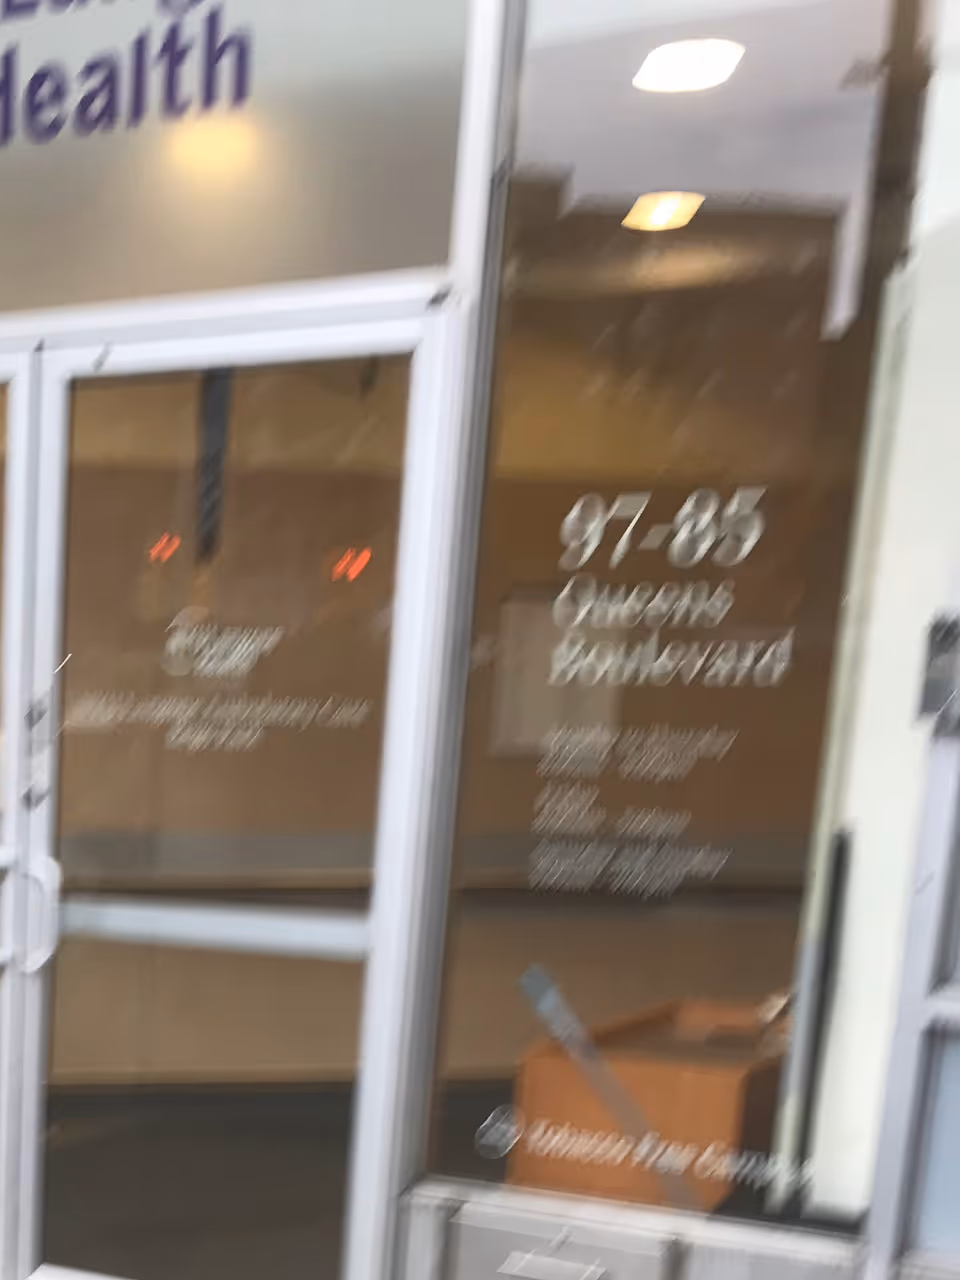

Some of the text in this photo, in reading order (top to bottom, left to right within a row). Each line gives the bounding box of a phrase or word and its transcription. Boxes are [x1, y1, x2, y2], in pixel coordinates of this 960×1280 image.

[557, 484, 768, 571] 97-85
[552, 571, 736, 629] Queens
[547, 625, 796, 688] Boulevard
